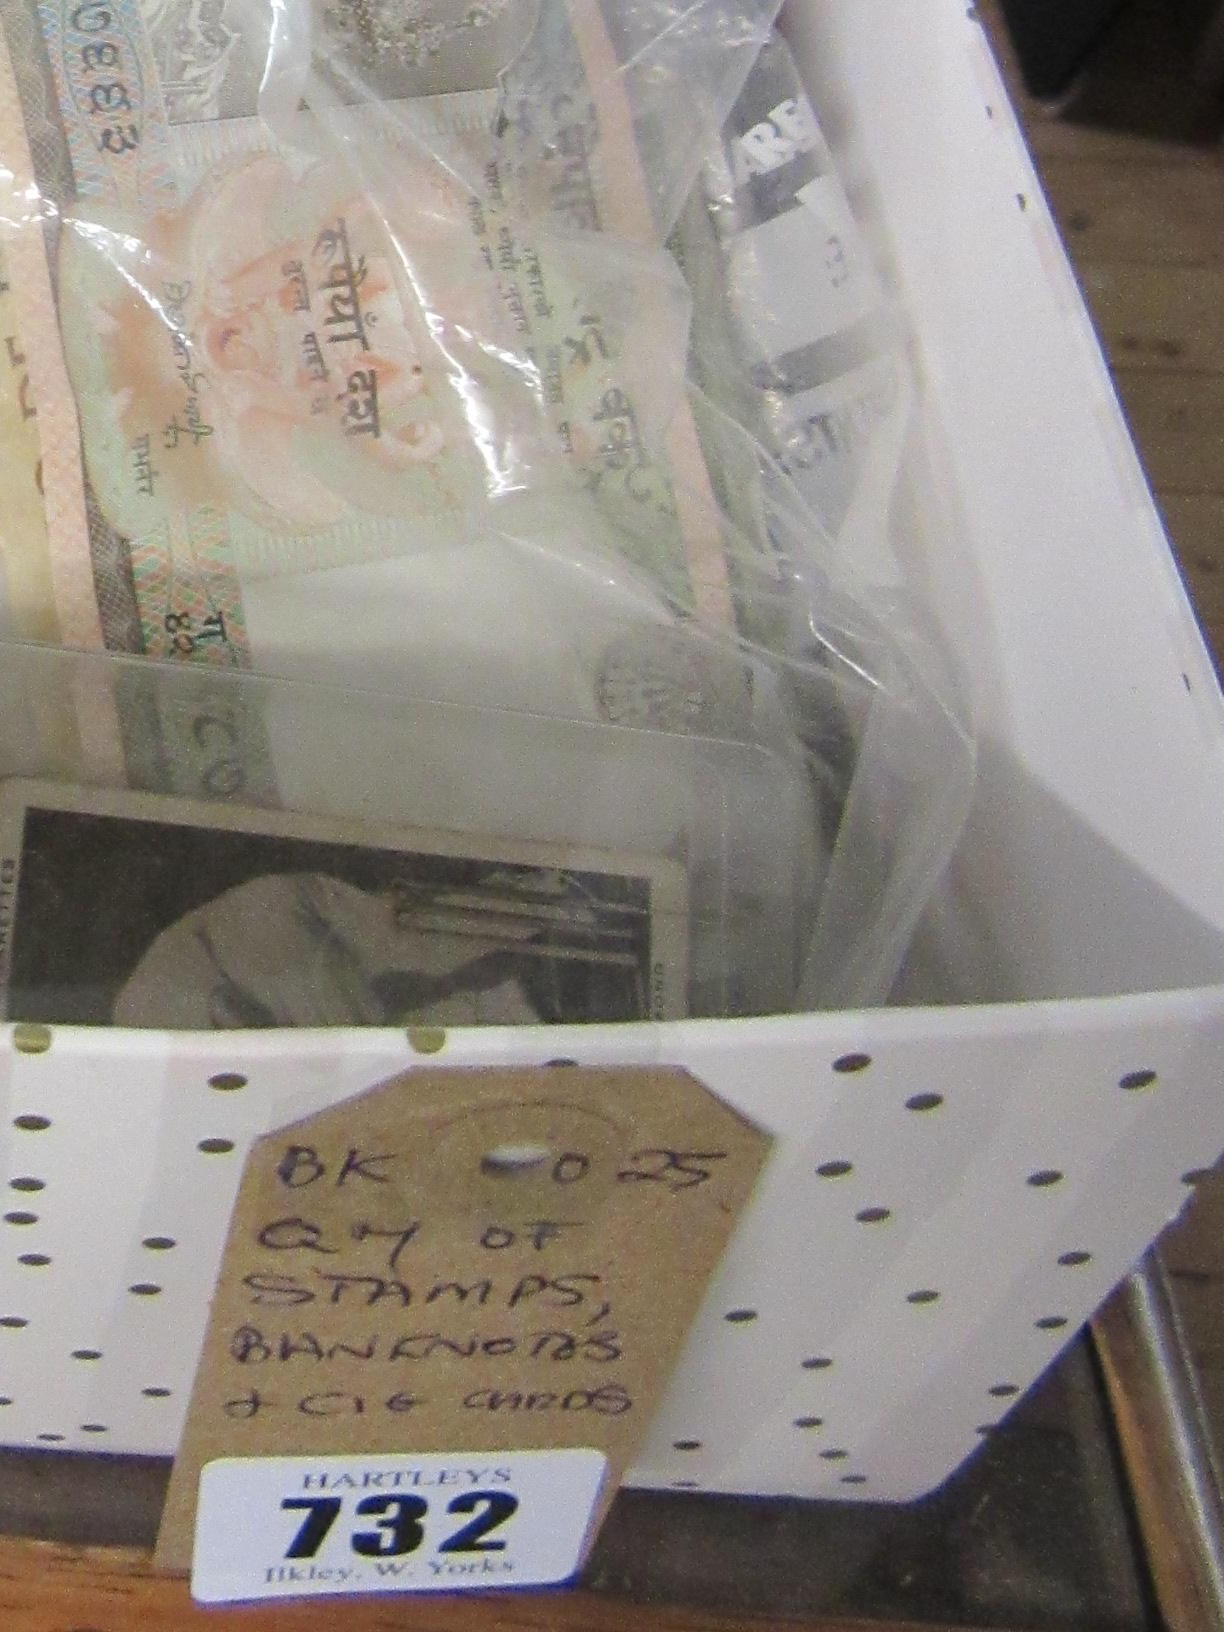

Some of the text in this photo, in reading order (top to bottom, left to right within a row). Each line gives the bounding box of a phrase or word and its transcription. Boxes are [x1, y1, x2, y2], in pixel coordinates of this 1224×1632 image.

[278, 1145, 398, 1188] BK
[480, 1220, 586, 1252] OF
[302, 1467, 514, 1490] HARTLEYS
[281, 1489, 520, 1559] 732
[427, 1557, 516, 1575] Yorks
